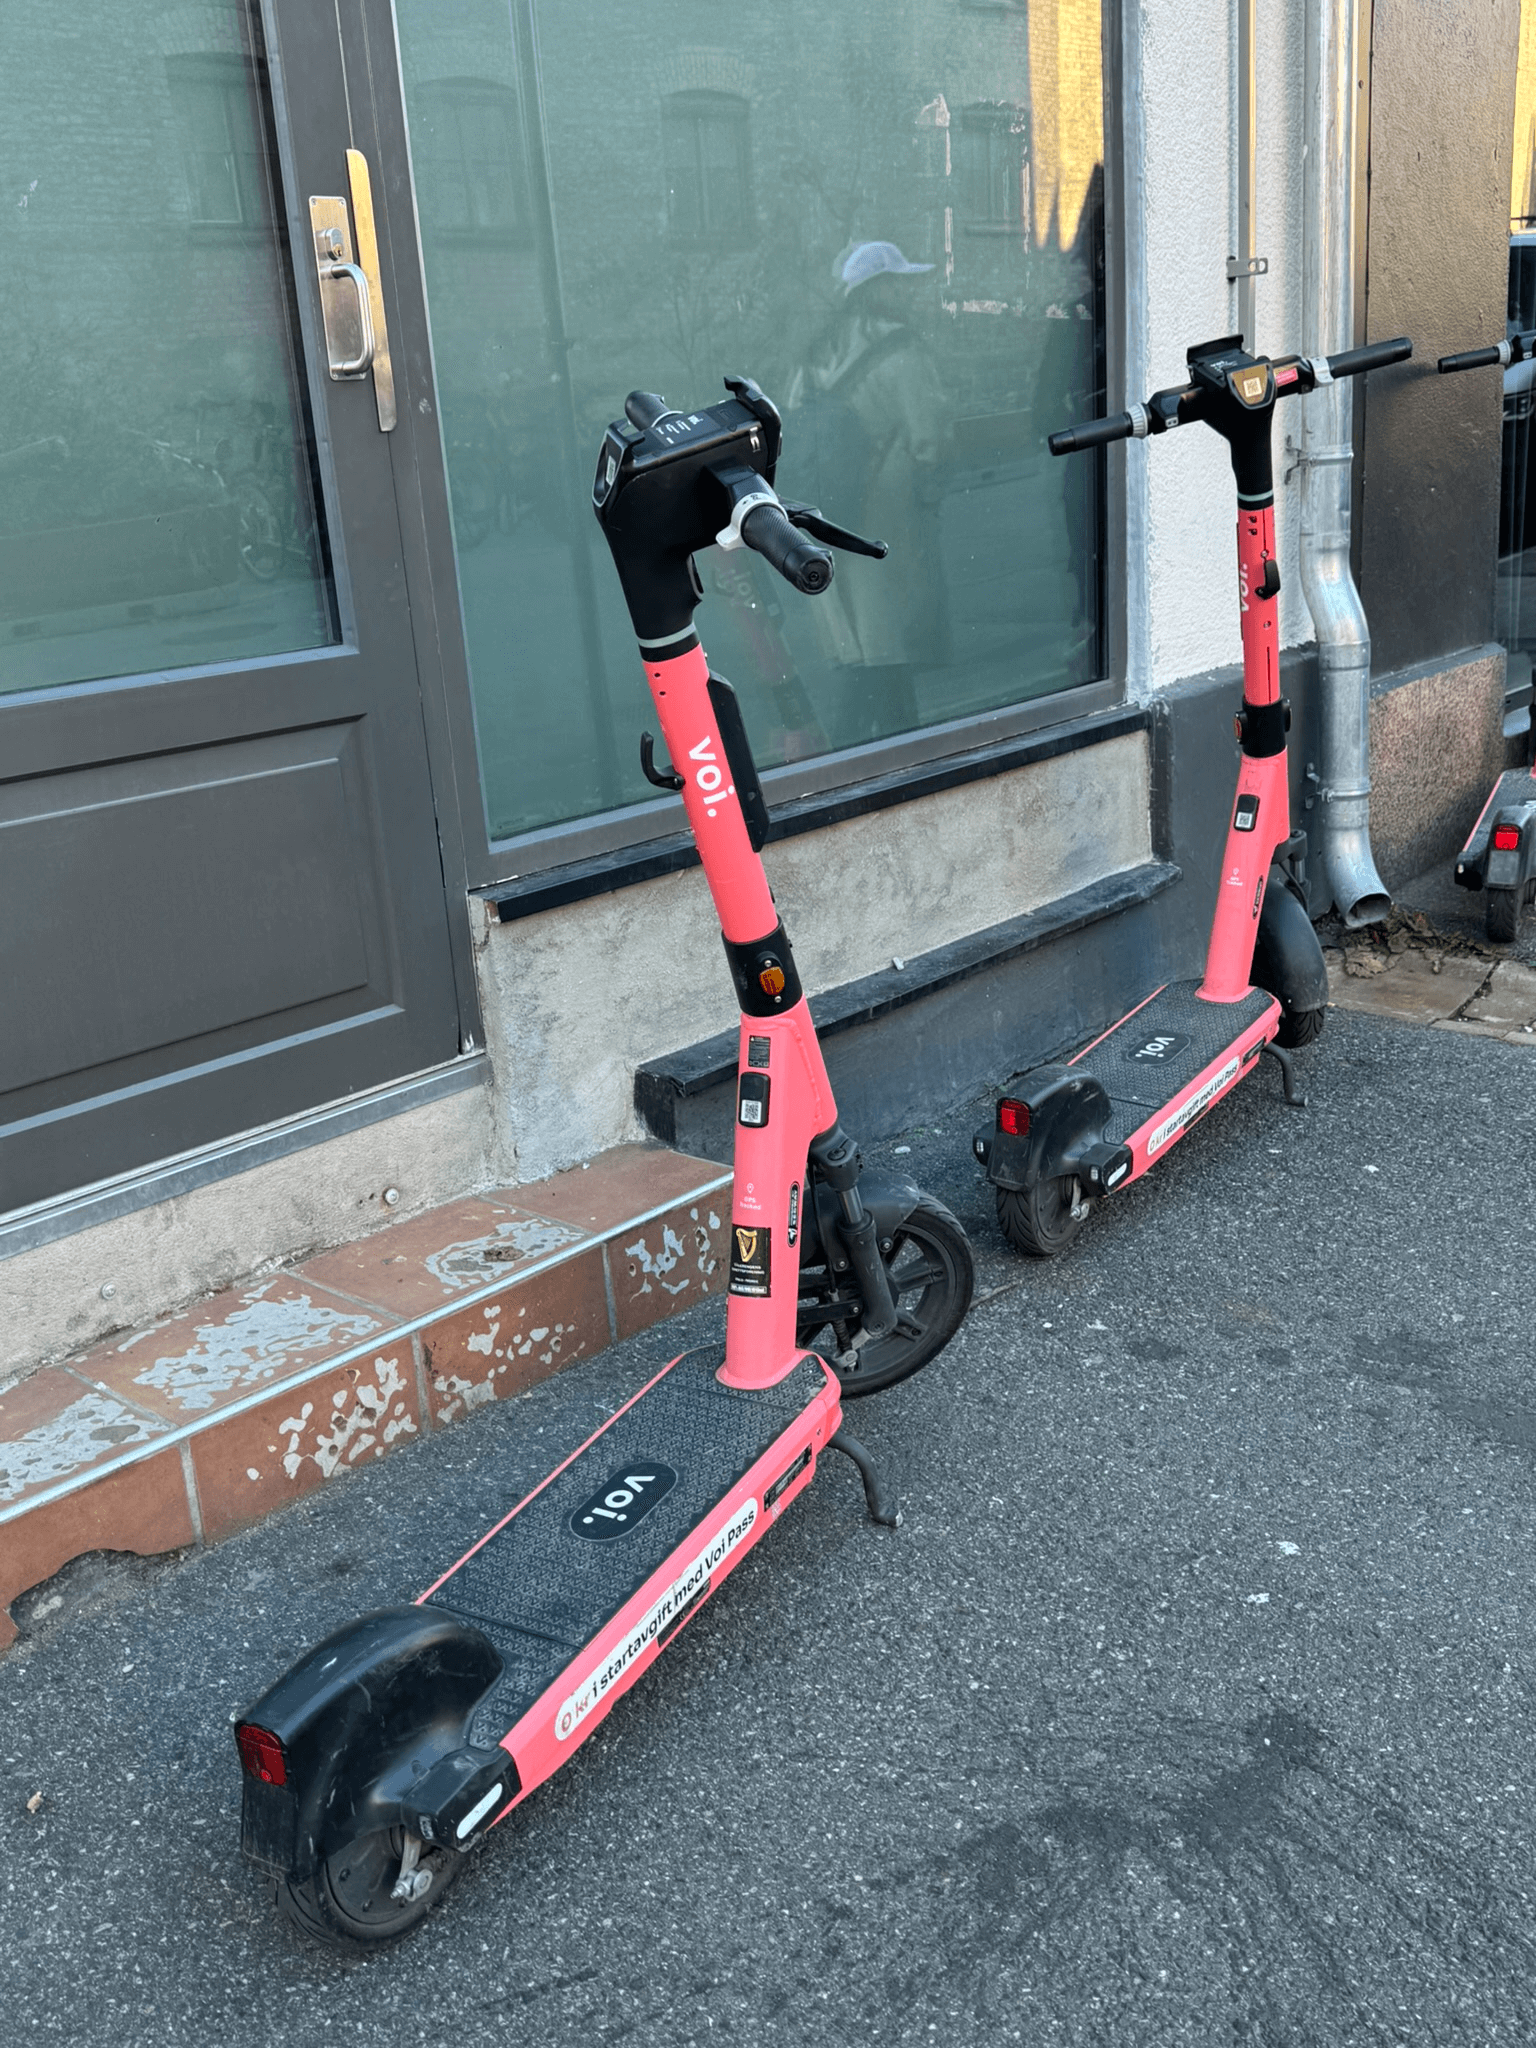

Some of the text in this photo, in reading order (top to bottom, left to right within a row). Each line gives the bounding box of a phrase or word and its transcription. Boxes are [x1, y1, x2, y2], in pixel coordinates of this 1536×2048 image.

[688, 735, 735, 818] voi.
[1135, 1036, 1176, 1058] voi.
[583, 1475, 656, 1524] voi.
[562, 1712, 572, 1733] 0
[592, 1681, 598, 1698] i
[600, 1599, 674, 1690] startavgift
[674, 1563, 704, 1607] med
[704, 1538, 726, 1570] Voi
[727, 1510, 755, 1548] Pass
